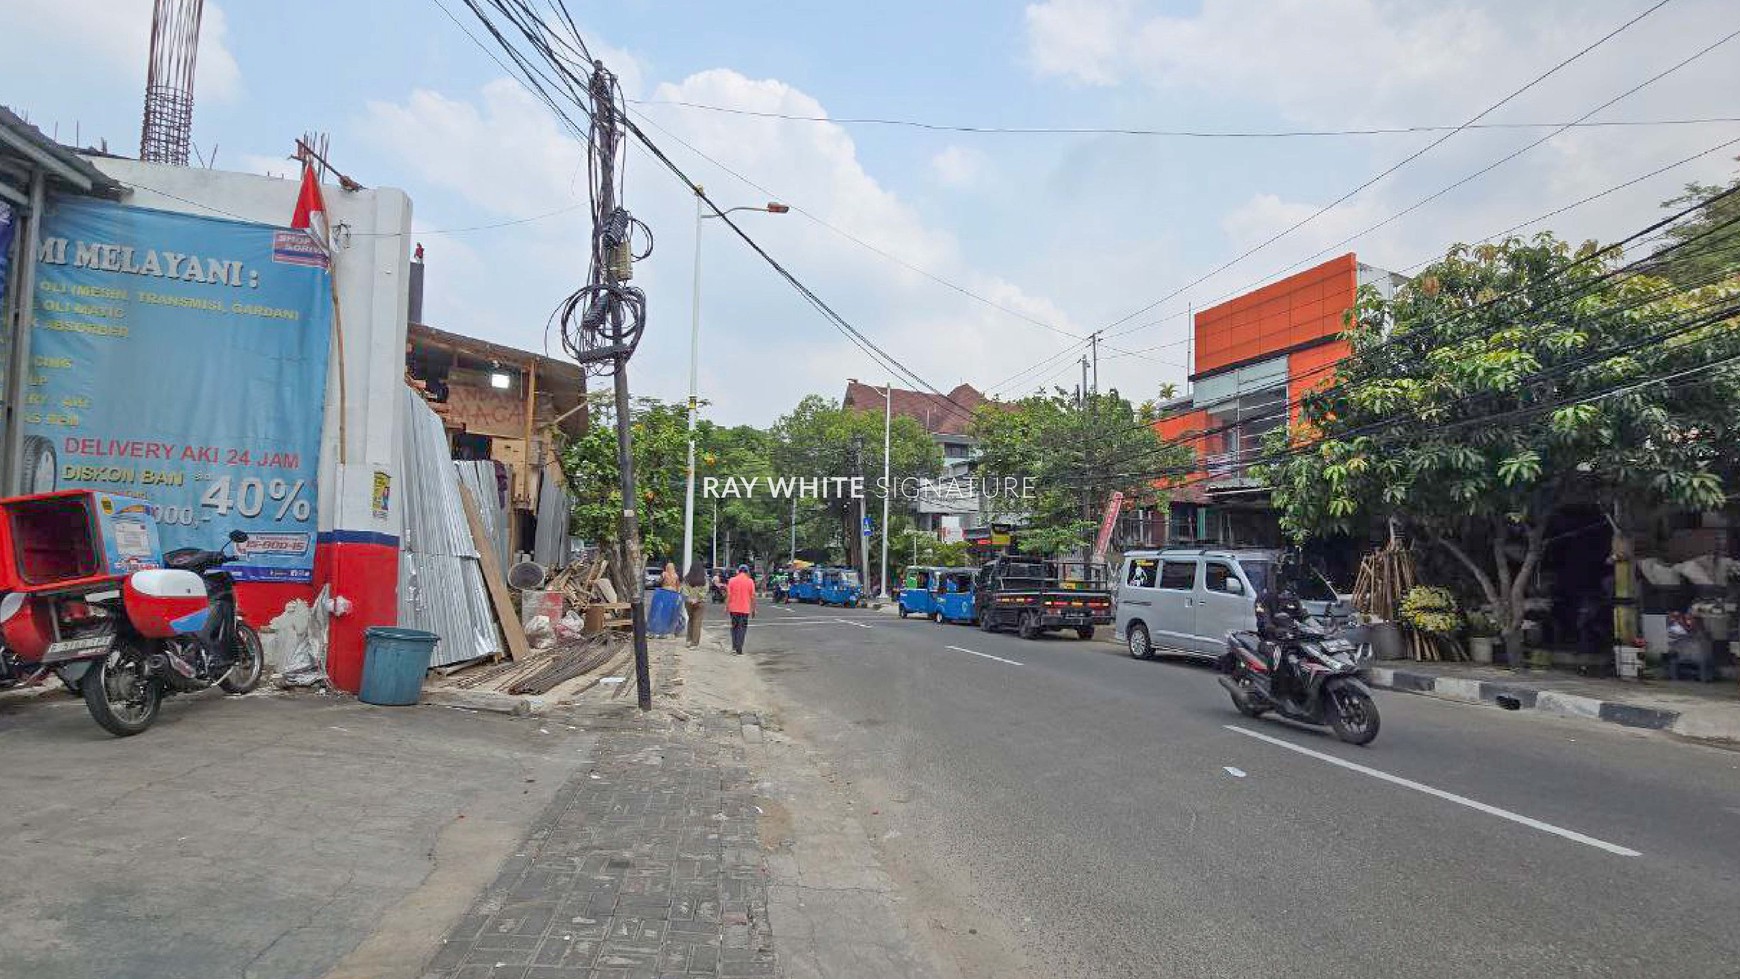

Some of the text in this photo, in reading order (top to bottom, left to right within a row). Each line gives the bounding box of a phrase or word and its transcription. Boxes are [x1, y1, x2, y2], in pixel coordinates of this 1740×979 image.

[73, 240, 244, 287] MELAYANI
[64, 437, 300, 469] DELIVERY AKI 24 JAM
[63, 464, 136, 485] DISKON
[142, 468, 185, 487] BAN
[201, 475, 311, 523] 40%
